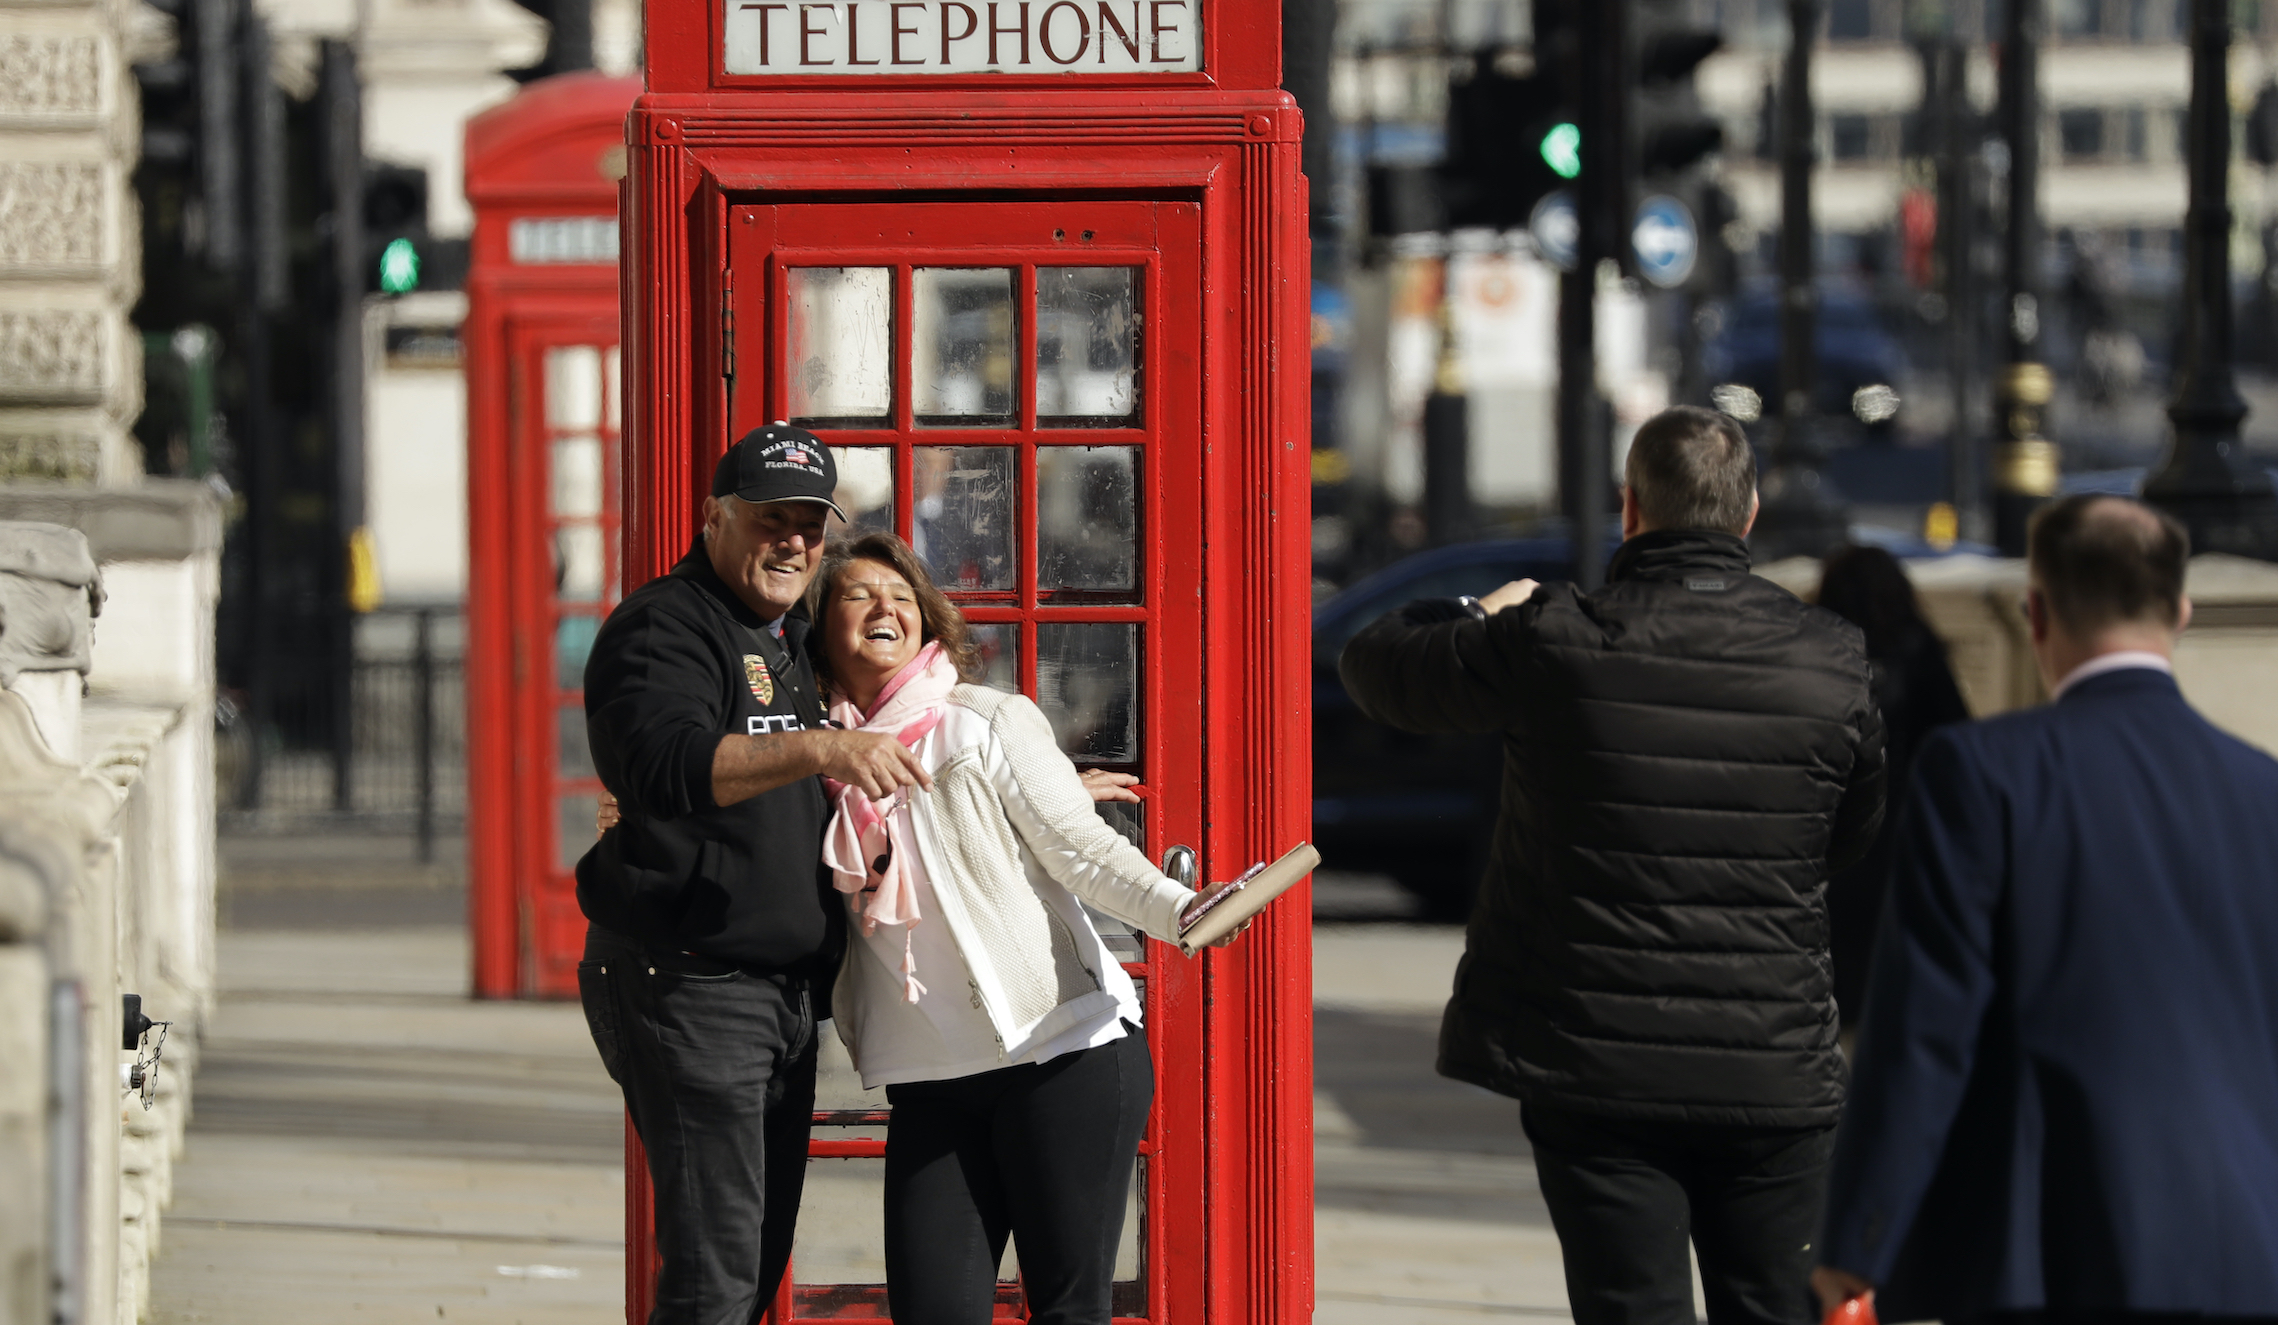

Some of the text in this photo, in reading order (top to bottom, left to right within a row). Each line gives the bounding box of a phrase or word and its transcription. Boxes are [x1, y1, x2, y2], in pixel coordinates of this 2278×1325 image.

[739, 0, 1187, 66] TELEPHONE
[761, 441, 796, 456] MIAMI
[808, 465, 825, 476] USA
